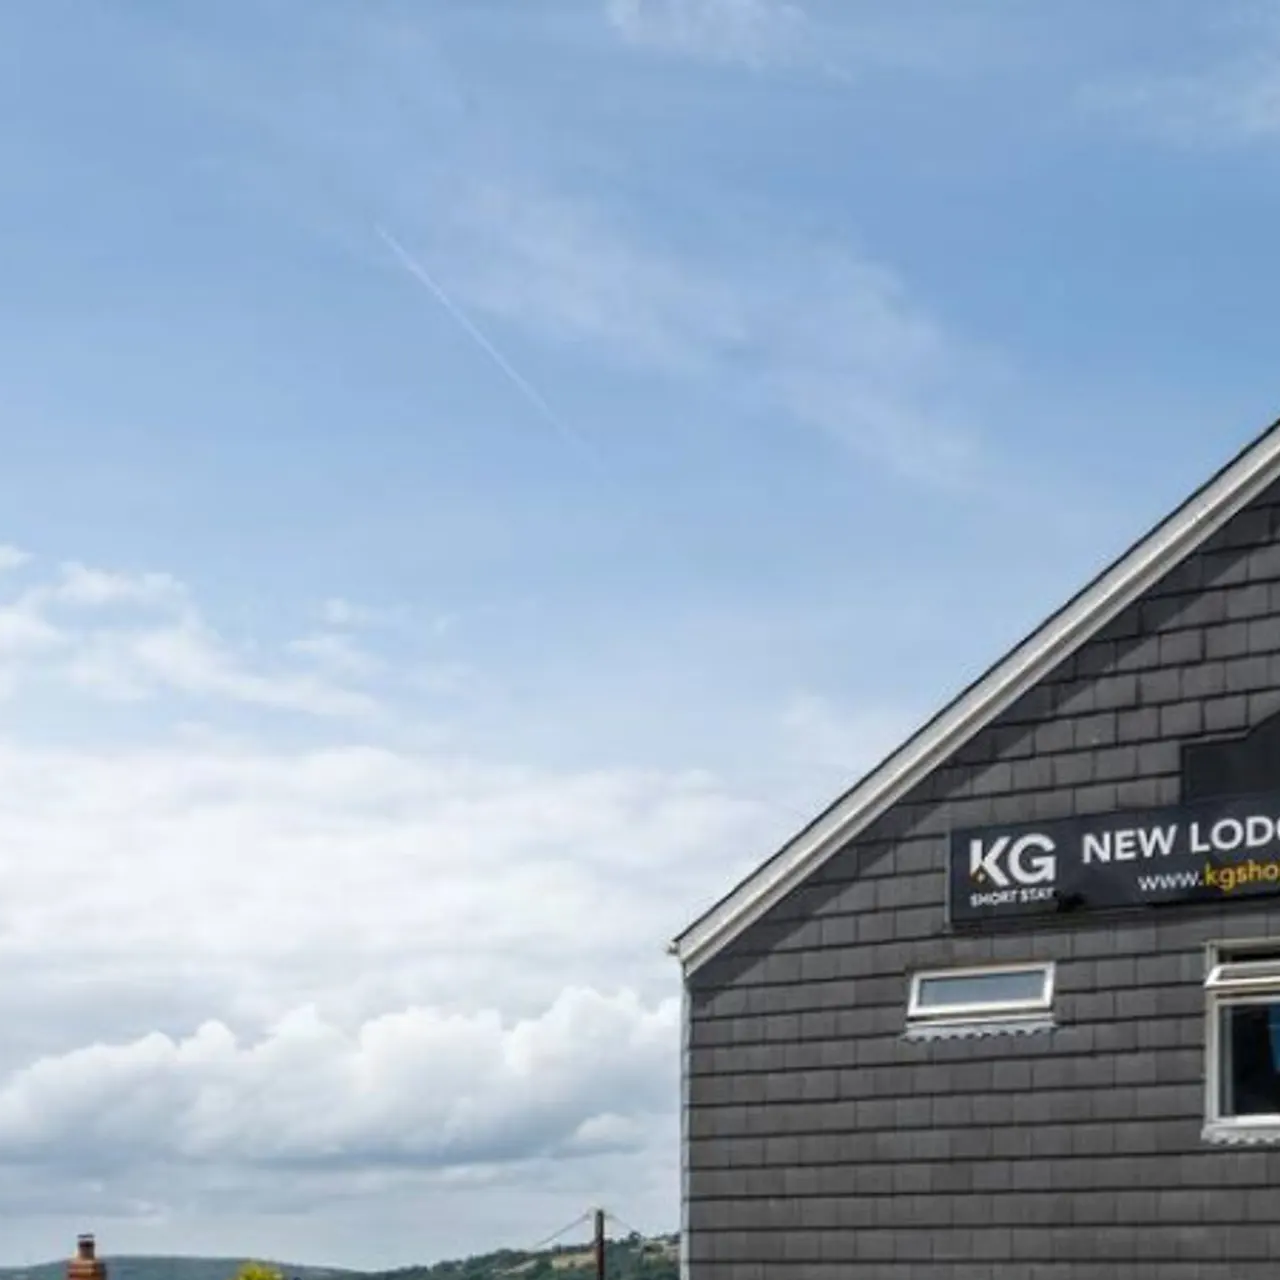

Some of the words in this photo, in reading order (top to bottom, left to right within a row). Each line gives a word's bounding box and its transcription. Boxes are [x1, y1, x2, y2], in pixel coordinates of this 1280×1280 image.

[969, 833, 1056, 887] KG
[1082, 825, 1178, 864] NEW
[970, 890, 1018, 908] SHORT
[1020, 887, 1055, 902] STAY
